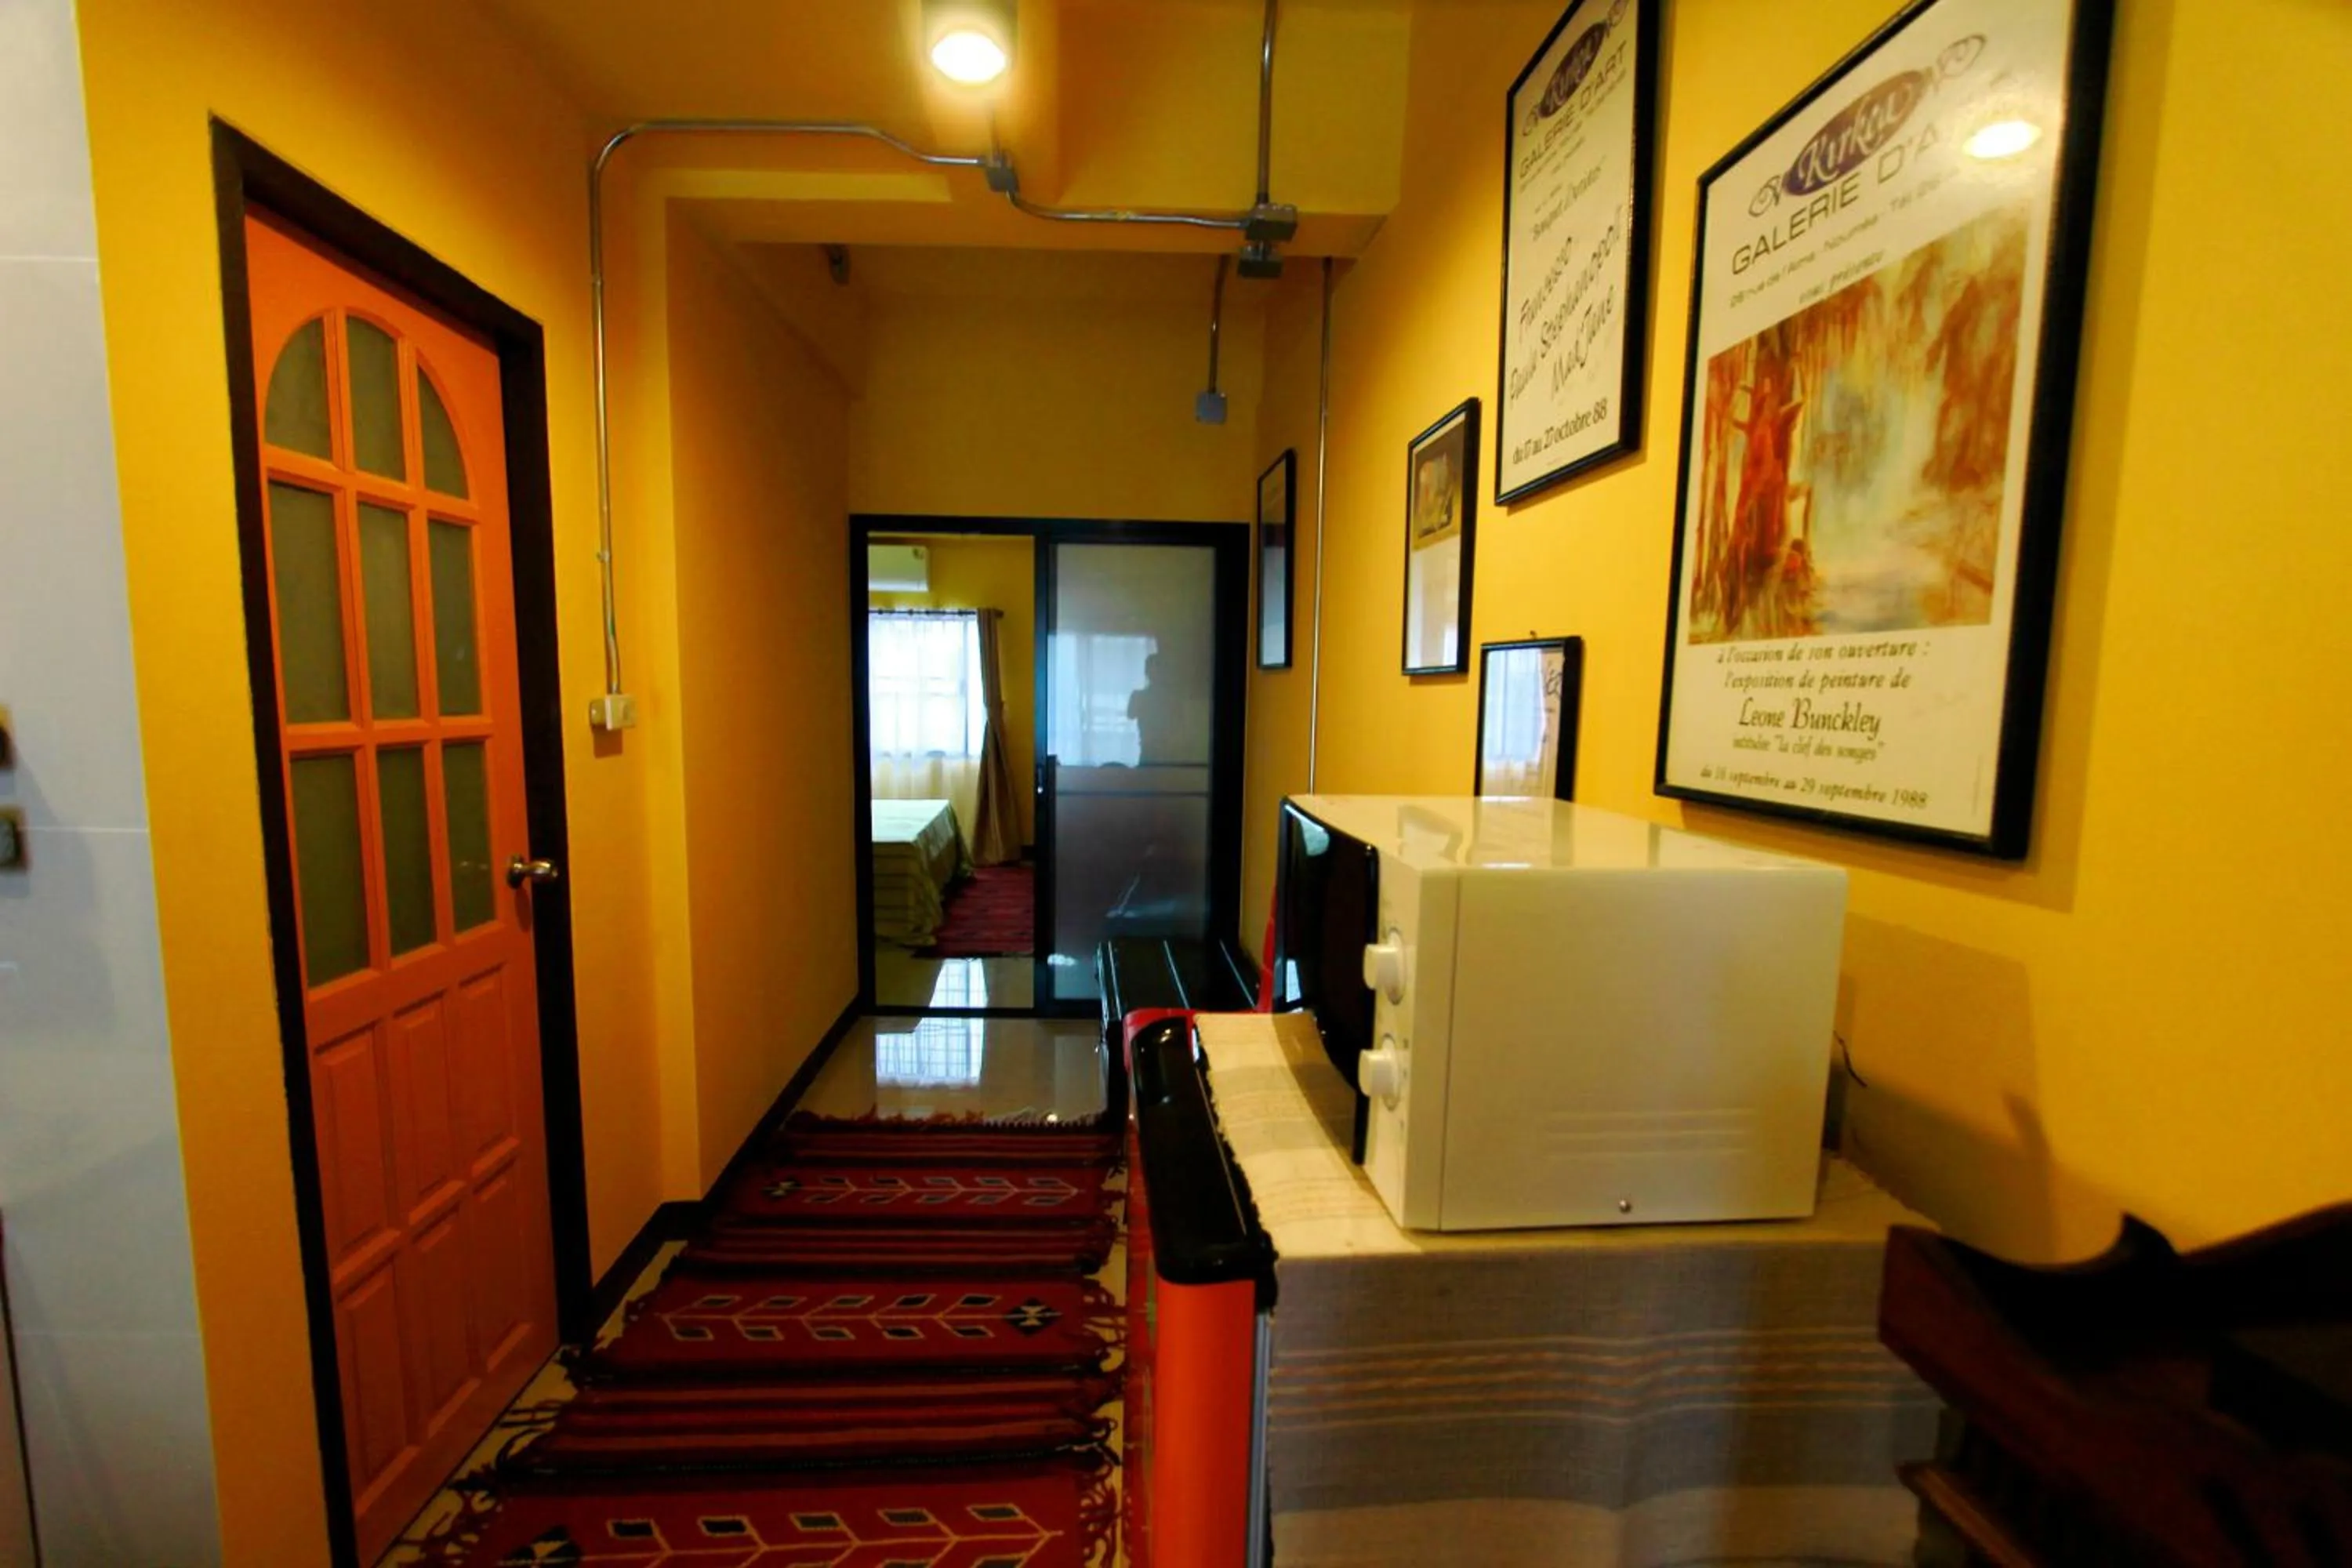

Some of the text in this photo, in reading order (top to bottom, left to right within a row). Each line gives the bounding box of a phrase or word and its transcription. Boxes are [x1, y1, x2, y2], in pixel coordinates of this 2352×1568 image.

[1519, 104, 1574, 179] GALERIE
[1732, 171, 1861, 275] GALERIE
[1554, 411, 1592, 444] octobre
[1592, 397, 1608, 424] 88
[1788, 641, 1802, 661] de
[1838, 641, 1918, 660] ouverture
[1798, 669, 1815, 688] de
[1819, 670, 1885, 695] peinture
[1890, 666, 1911, 689] de
[1738, 696, 1881, 742] Leone Bunckley
[1820, 783, 1887, 802] septembre
[1891, 788, 1929, 809] 1988
